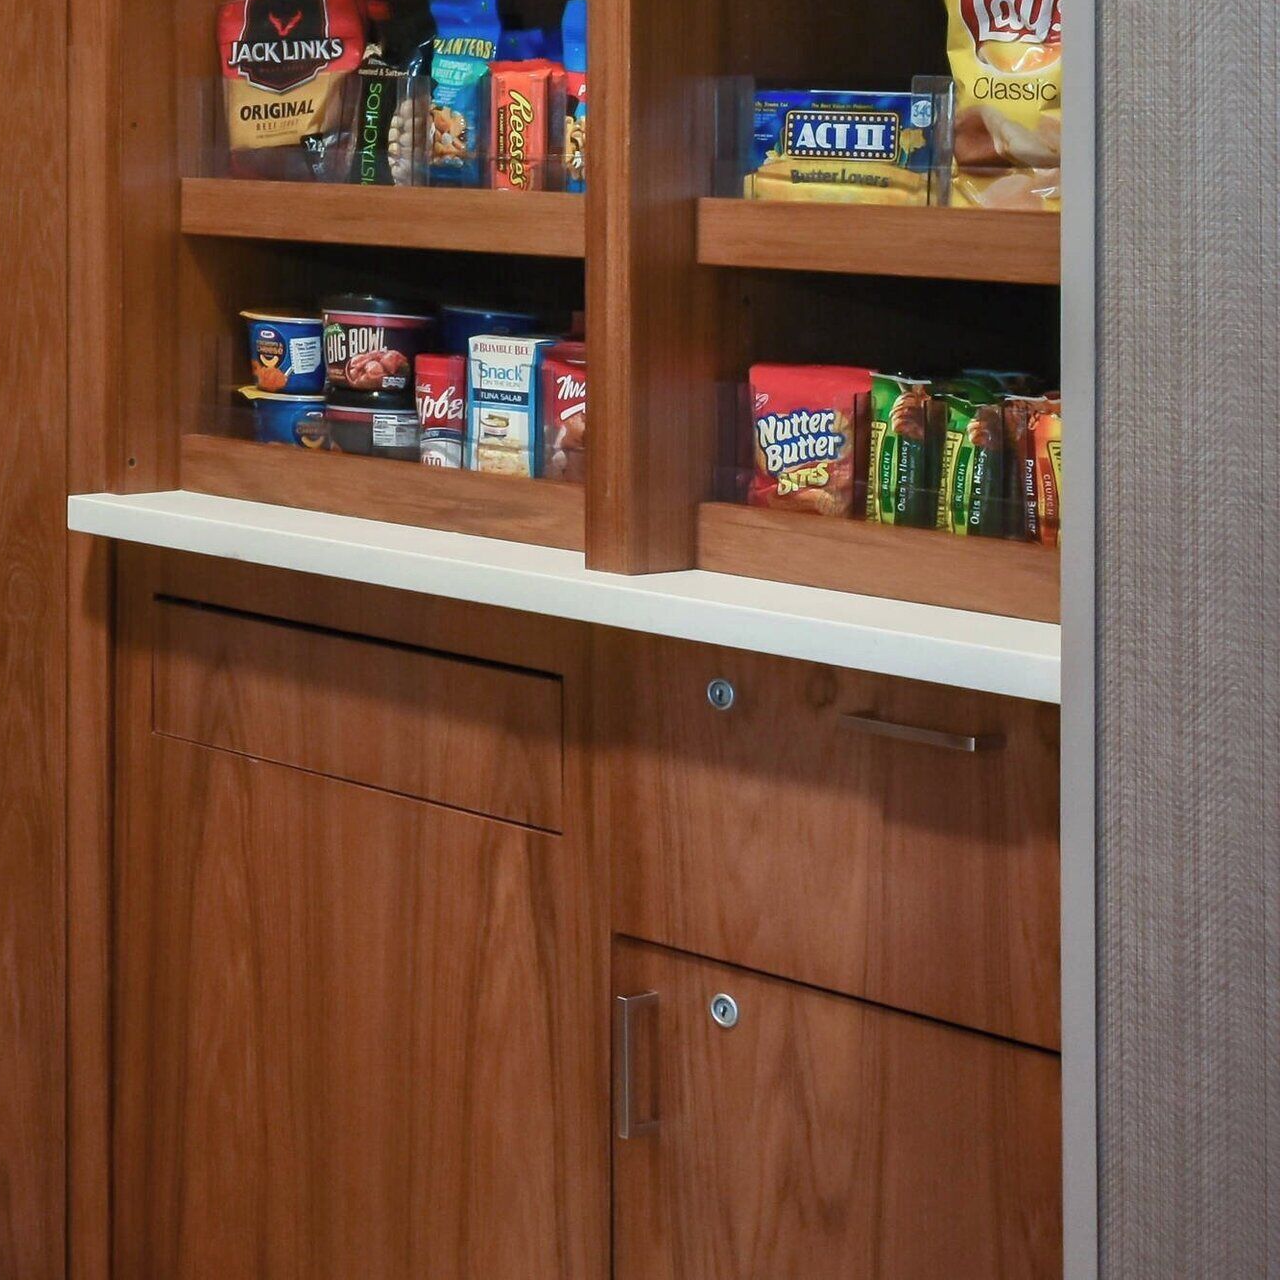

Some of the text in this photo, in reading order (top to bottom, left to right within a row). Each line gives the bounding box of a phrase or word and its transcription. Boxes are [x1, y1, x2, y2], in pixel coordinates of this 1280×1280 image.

[228, 40, 282, 65] JACK
[433, 37, 494, 60] PLANTERS
[973, 77, 1058, 101] Classic
[240, 98, 315, 121] ORIGINAL
[508, 88, 534, 191] Reese's
[796, 122, 887, 150] ACT II
[790, 168, 890, 187] Butter Lovers
[326, 332, 346, 363] BIG
[348, 326, 389, 358] BOWL
[479, 342, 531, 356] BUMBLE BEE
[478, 362, 524, 382] Snack
[480, 393, 499, 401] TUNA
[757, 410, 835, 447] Nutter
[765, 433, 841, 471] Butter
[777, 463, 830, 497] BITES
[1025, 459, 1034, 496] Peanut
